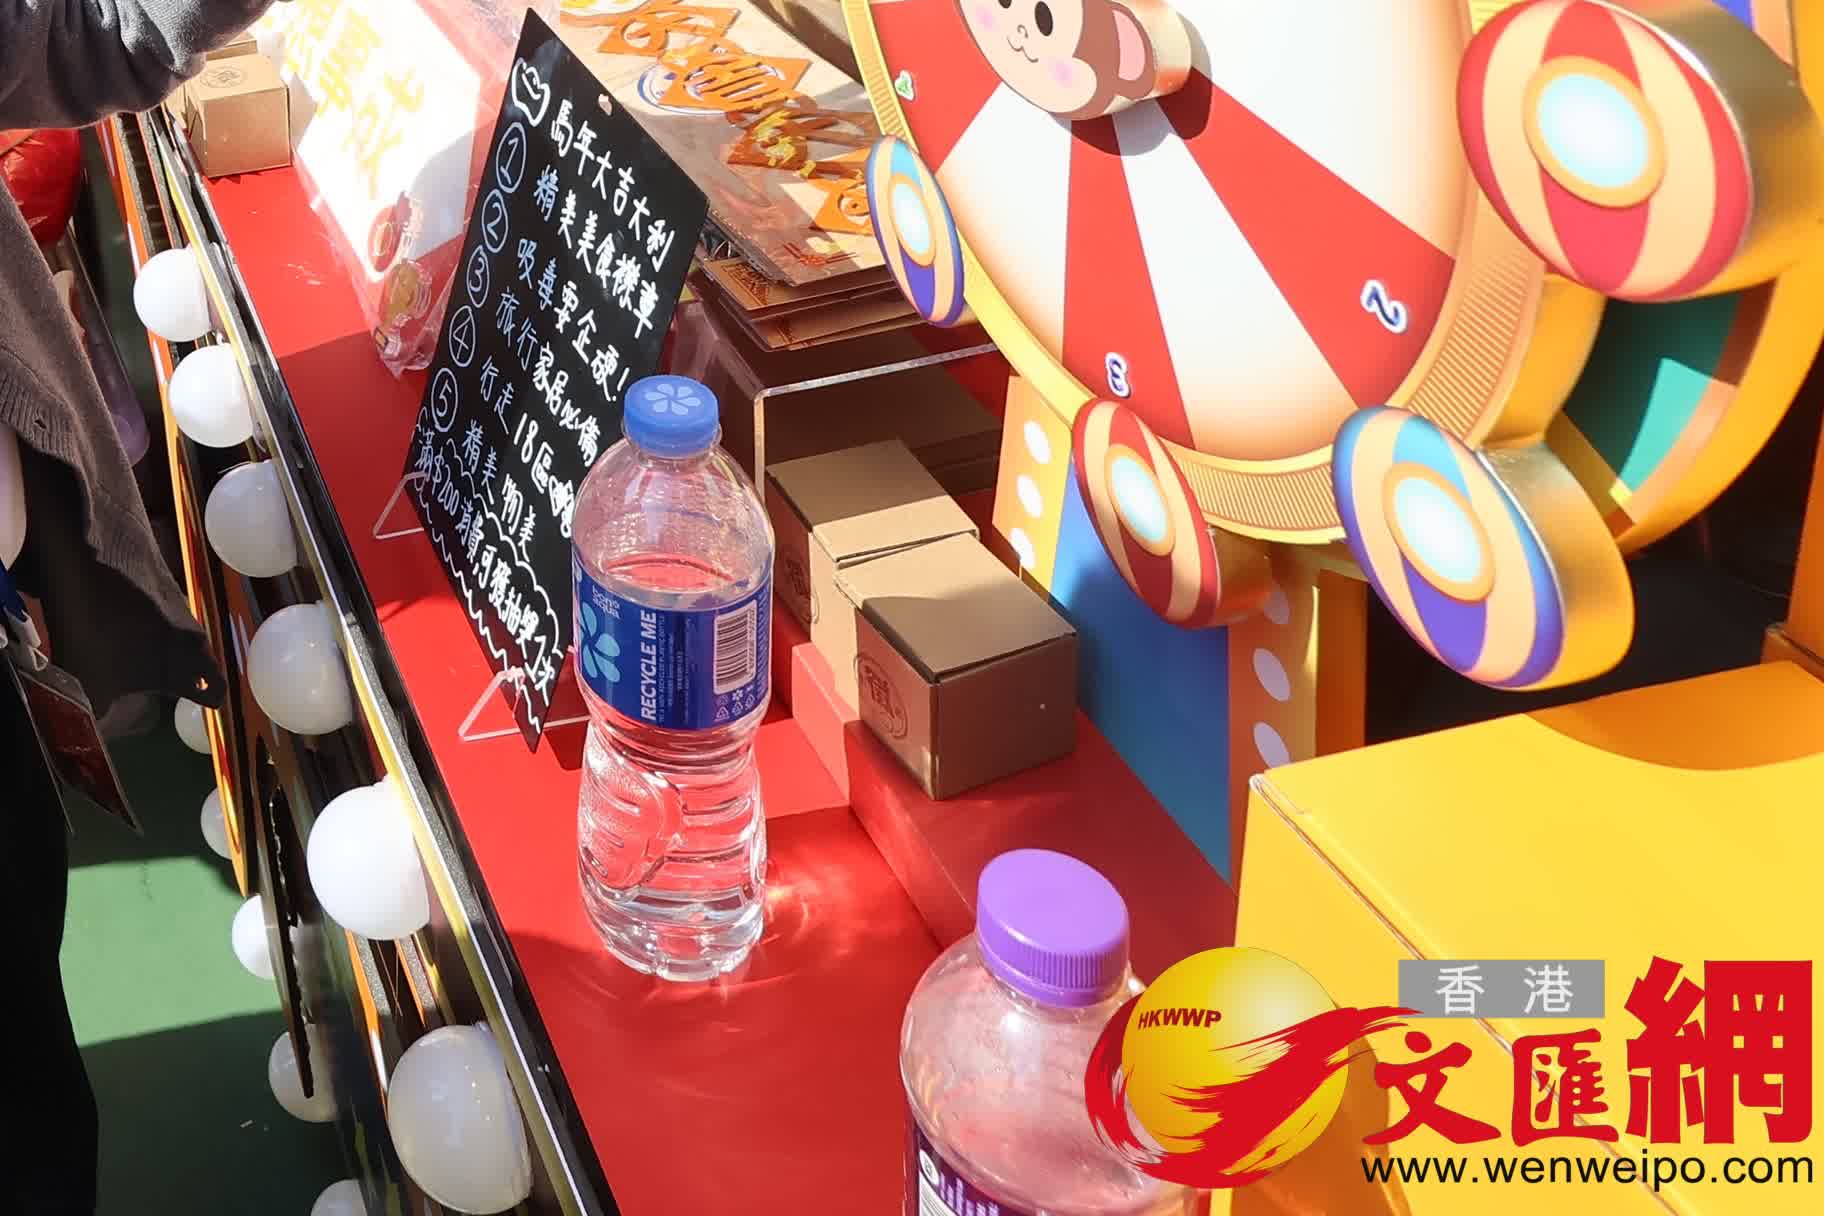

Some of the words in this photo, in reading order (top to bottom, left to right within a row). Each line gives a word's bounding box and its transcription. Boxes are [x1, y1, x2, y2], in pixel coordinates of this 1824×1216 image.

[550, 99, 675, 273] 馬年大吉大利
[640, 610, 657, 640] ME
[640, 642, 657, 720] RECYCLE
